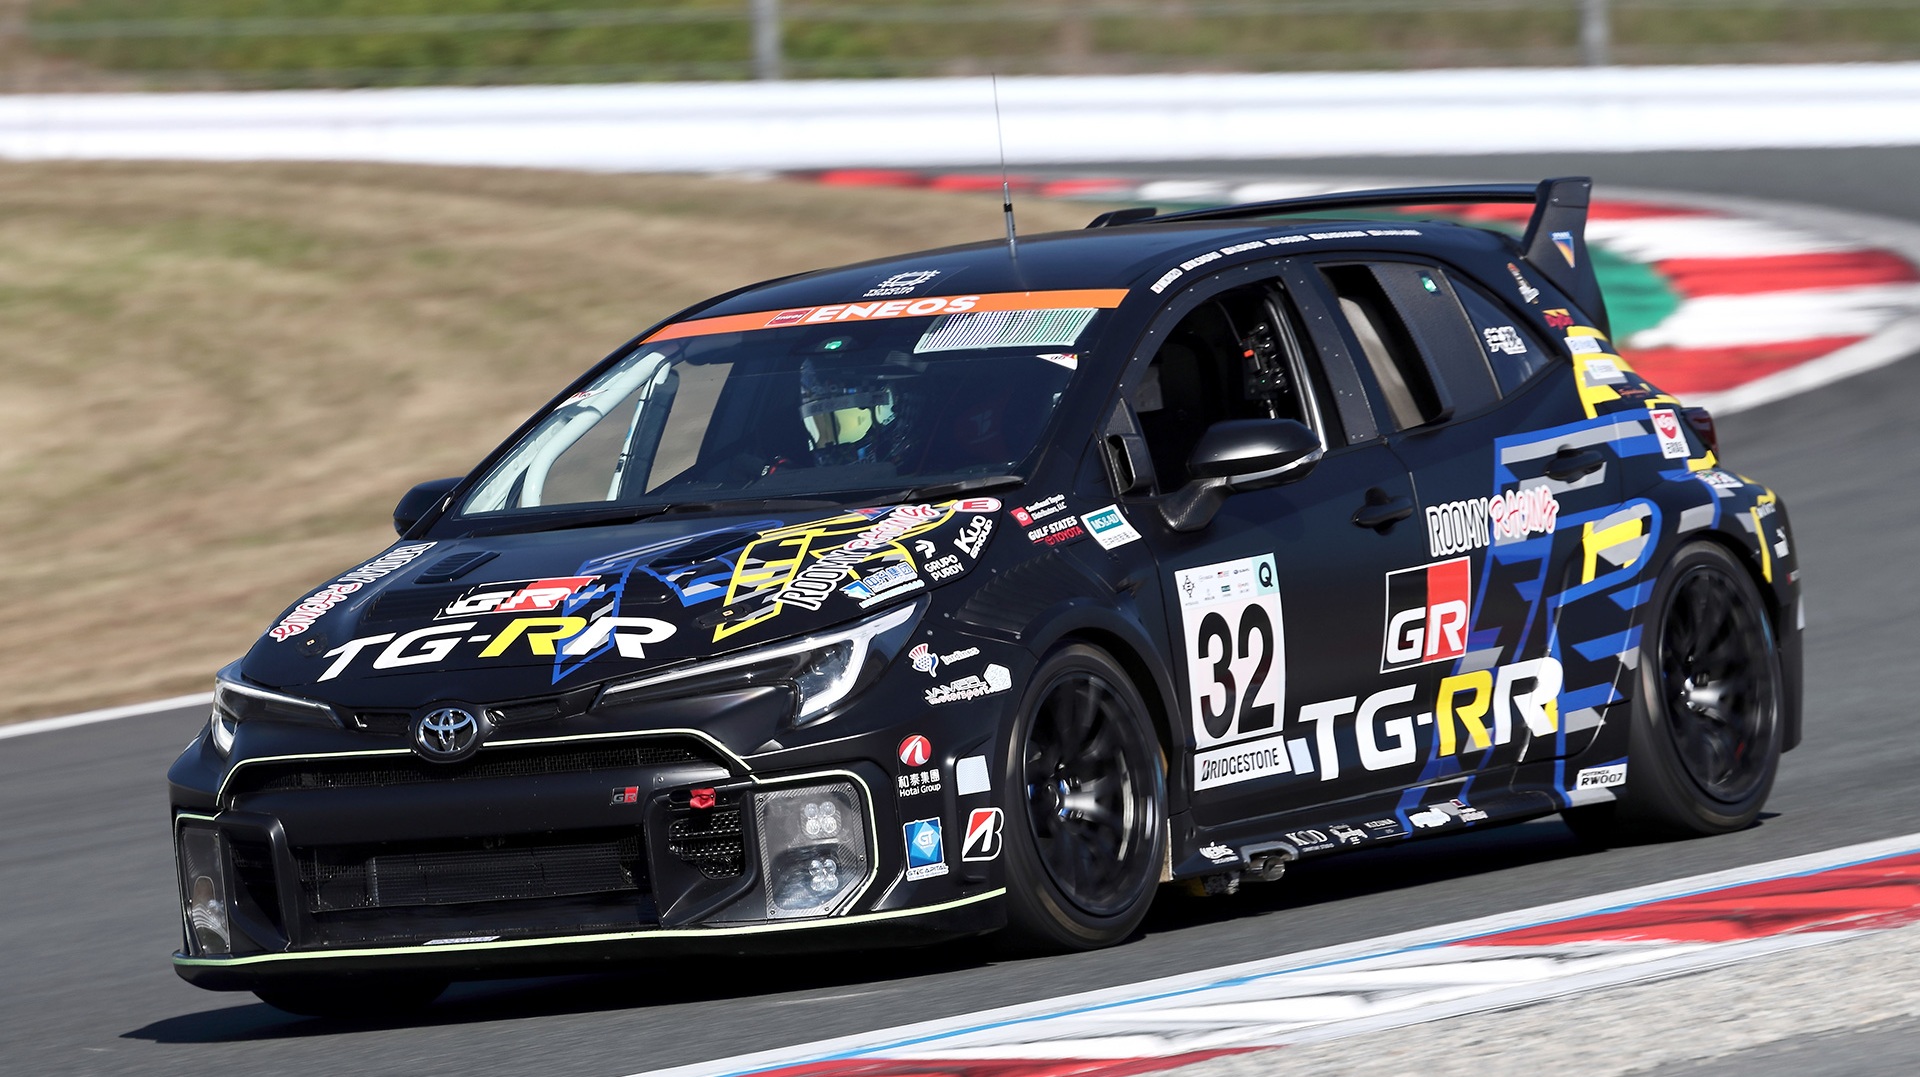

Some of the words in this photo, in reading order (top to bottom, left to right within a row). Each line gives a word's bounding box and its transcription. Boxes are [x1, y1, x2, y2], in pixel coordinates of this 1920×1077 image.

[805, 296, 980, 323] ENEOS
[1028, 524, 1049, 541] GULF
[1048, 515, 1078, 534] STATES
[1090, 513, 1121, 530] MS&AD
[1427, 497, 1491, 557] ROOMY
[1489, 485, 1560, 541] RACING
[953, 515, 987, 554] KUO
[969, 519, 993, 559] GROUP
[1055, 526, 1084, 543] TOYOTA
[924, 554, 958, 573] GRUPO
[930, 562, 965, 581] PURDY
[1258, 562, 1274, 588] Q
[773, 546, 872, 611] ROOMY
[445, 588, 572, 615] GR
[1386, 599, 1467, 665] GR
[317, 616, 677, 682] TG-RR
[1198, 603, 1275, 739] 32
[1298, 656, 1563, 782] TG-RR
[1201, 747, 1280, 782] BRIDGESTONE
[898, 768, 941, 788] 和泰集團
[899, 786, 920, 798] Hotai
[920, 783, 942, 795] Group
[1581, 773, 1623, 786] RW007
[613, 793, 637, 803] GR
[1364, 818, 1397, 829] KIZUNA
[1285, 829, 1328, 847] KOD
